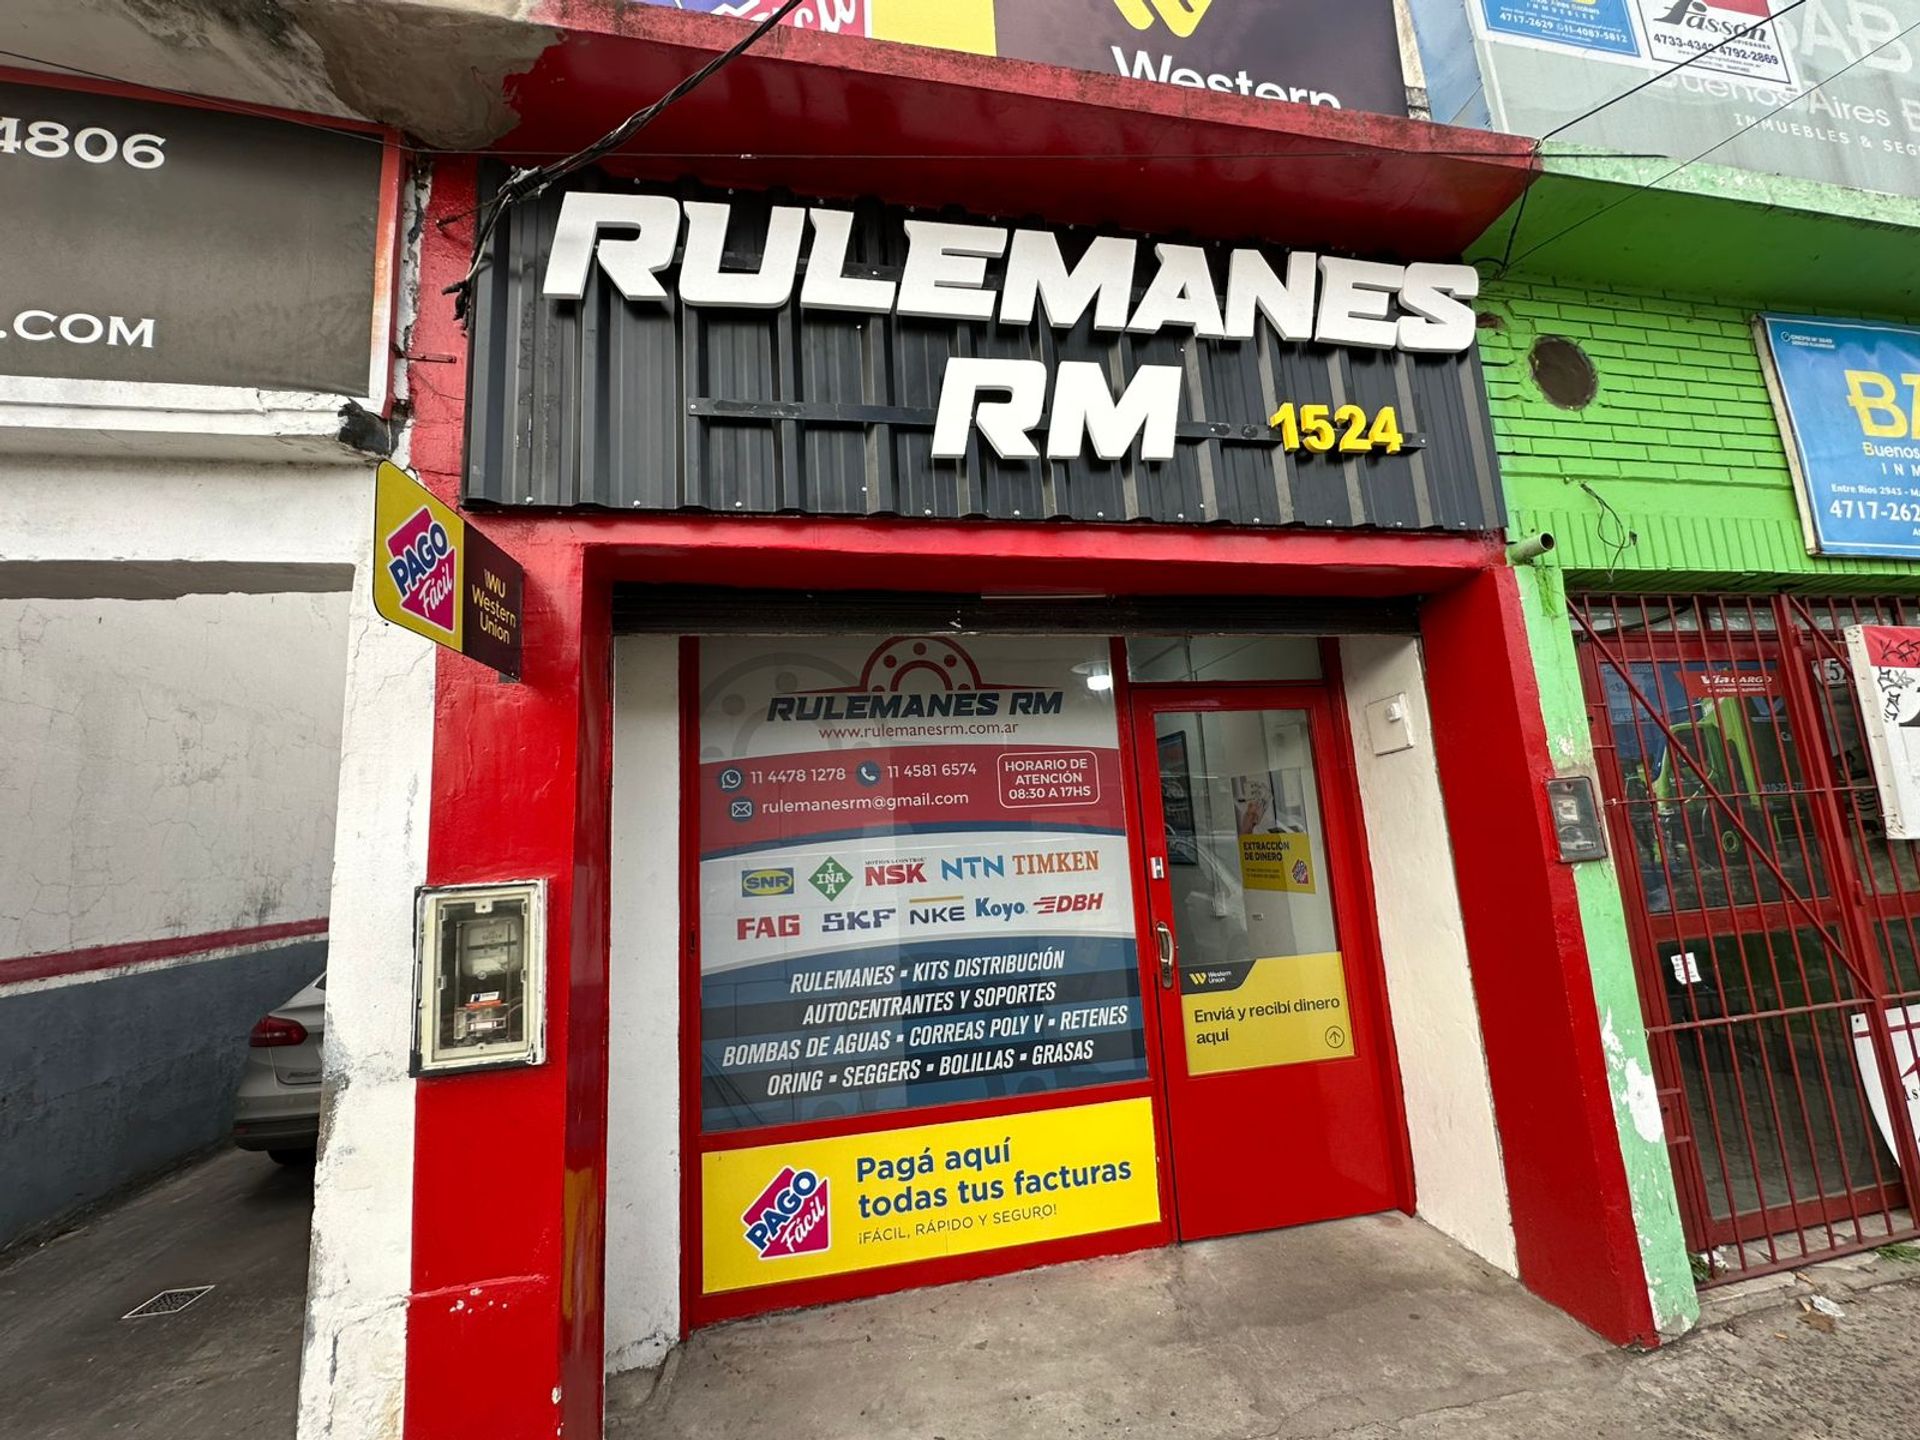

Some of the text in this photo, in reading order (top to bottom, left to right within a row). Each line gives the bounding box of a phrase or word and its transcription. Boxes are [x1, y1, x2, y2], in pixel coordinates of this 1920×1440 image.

[1808, 86, 1892, 128] Aires
[1733, 112, 1851, 145] INMUEBLES
[542, 191, 1480, 354] RULEMANES
[930, 357, 1183, 462] RM
[1269, 402, 1403, 455] 1524
[1861, 441, 1920, 460] Buenos
[388, 522, 448, 595] PAGO
[418, 563, 454, 618] Fácil
[471, 584, 517, 629] Western
[479, 613, 511, 645] Union
[766, 690, 1064, 722] RULEMANES RM
[818, 723, 1019, 739] www.rulemanesrm.com.ar
[750, 767, 847, 784] 11 4478 1278
[887, 762, 977, 778] 11 4581 6574
[1004, 758, 1088, 772] HORARIO DE
[1014, 770, 1083, 786] ATENCIÓN
[762, 792, 969, 814] rulemanesrm@gmail.com
[1008, 785, 1091, 800] 08:30 A 17HS
[941, 855, 1005, 882] NTN
[1012, 850, 1100, 876] TIMKEN
[1244, 851, 1283, 862] DE DINERO
[745, 876, 790, 890] SNR
[864, 863, 928, 887] NSK
[909, 905, 966, 925] NKE
[975, 897, 1026, 922] Koyo
[1055, 892, 1104, 913] DBH
[736, 914, 801, 941] FAG
[821, 907, 897, 933] SKF
[790, 946, 1066, 994] RULEMANES KITS DISTRIBUCIÓN
[1207, 970, 1232, 978] Western
[1208, 977, 1227, 985] Union
[802, 981, 1057, 1026] AUTOCENTRANTES Y SOPORTES
[1194, 996, 1341, 1023] Enviá y recibí dinero
[722, 1004, 1129, 1067] BOMBAS DE AGUAS CORREAS POLY V RETENES
[1196, 1028, 1229, 1045] aquí
[766, 1039, 1095, 1097] ORING SEGGERS BOLILLAS GRASAS
[856, 1136, 1011, 1183] Pagá aquí
[858, 1160, 1133, 1219] todas tus facturas
[745, 1170, 818, 1251] PAGO
[780, 1195, 826, 1253] Fácil
[858, 1203, 1058, 1245] ¡FÁCIL, RÁPIDO Y SEGURO!
